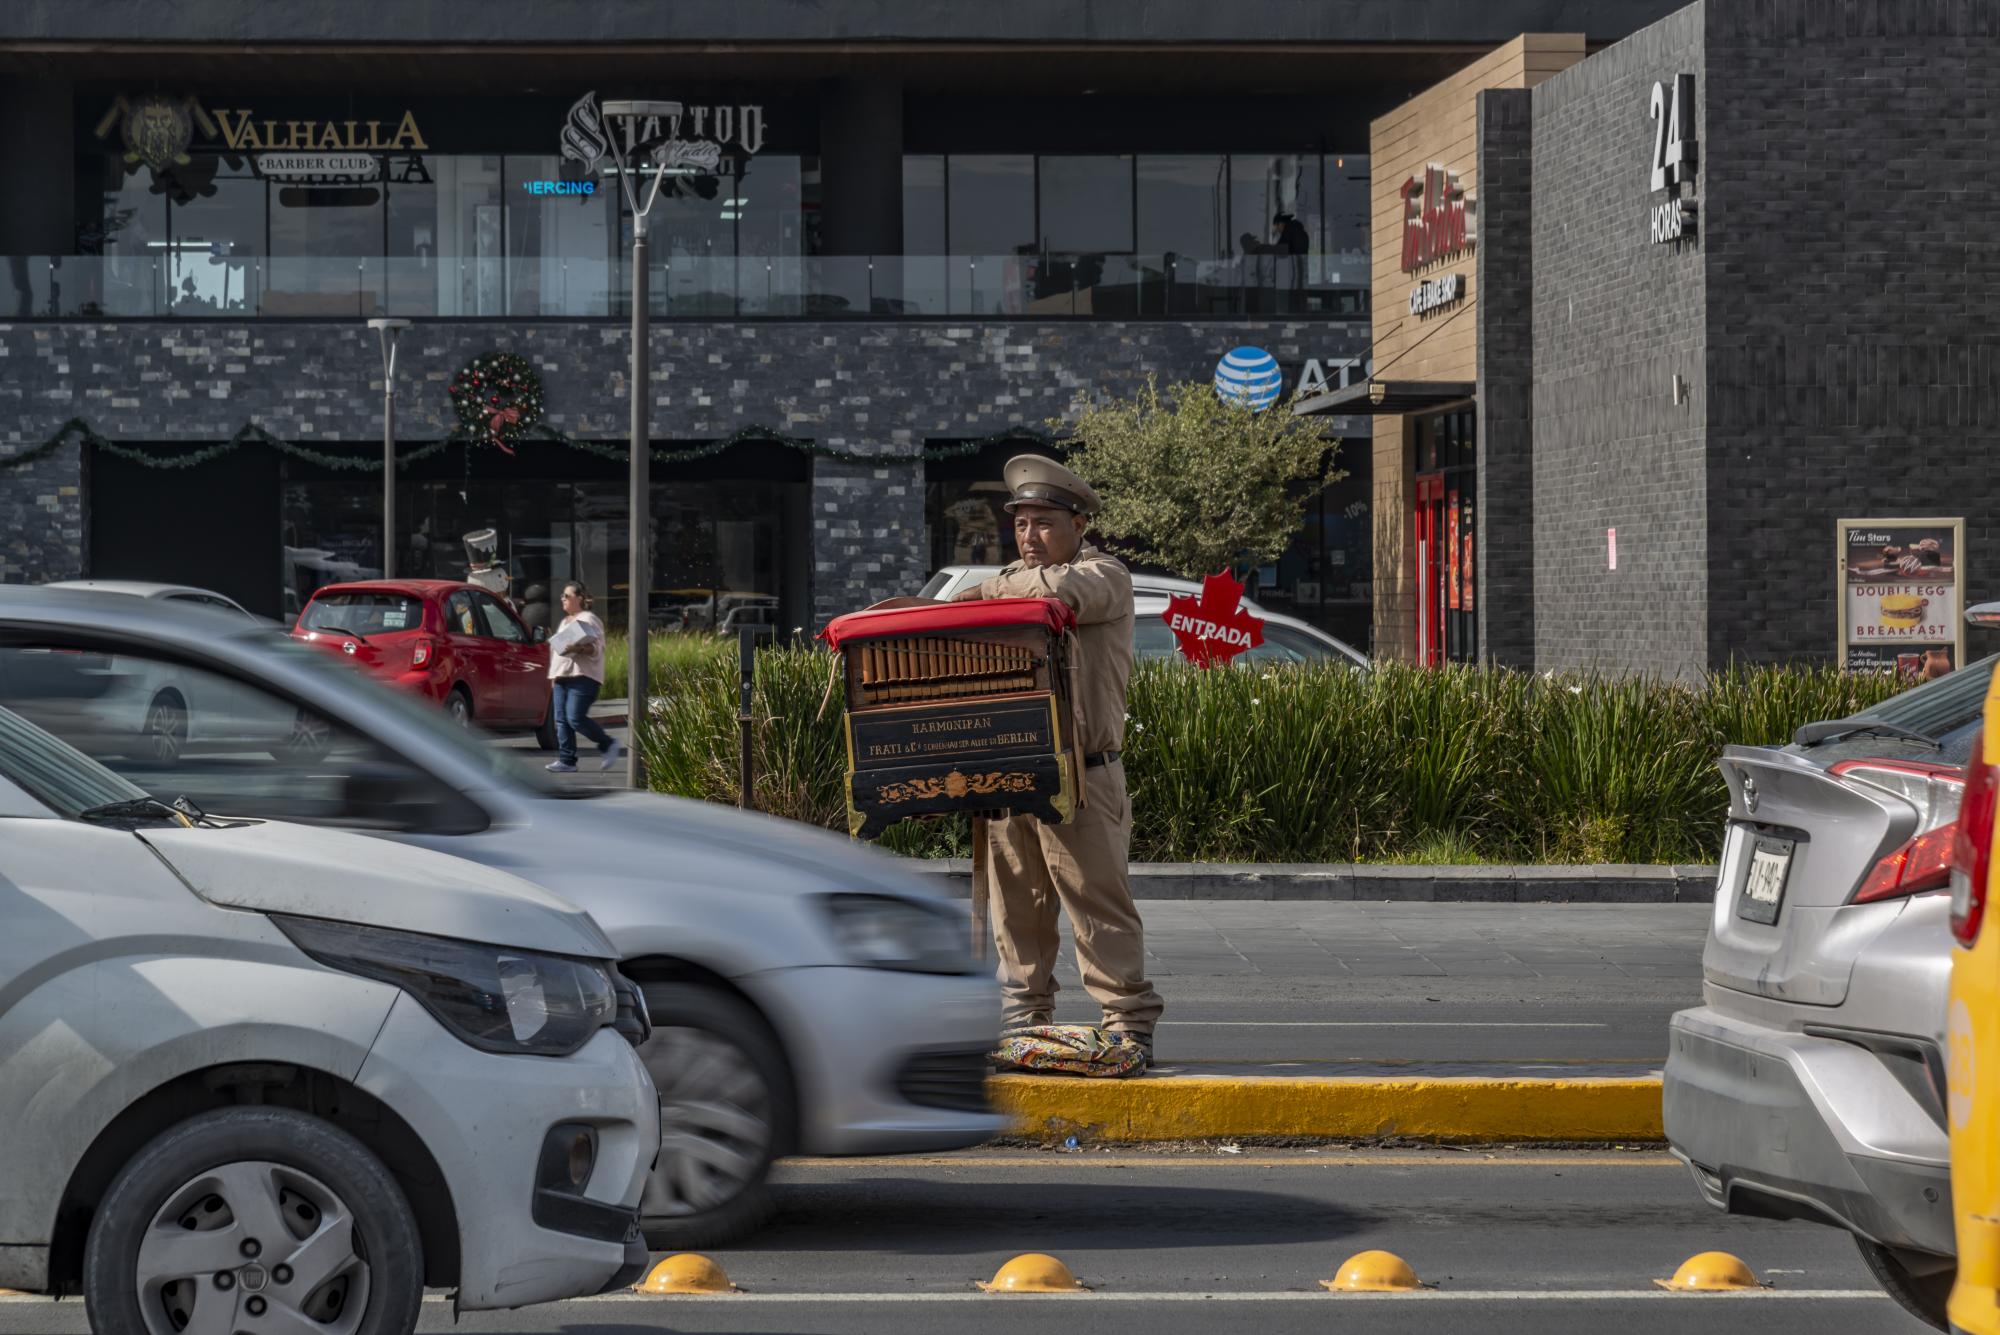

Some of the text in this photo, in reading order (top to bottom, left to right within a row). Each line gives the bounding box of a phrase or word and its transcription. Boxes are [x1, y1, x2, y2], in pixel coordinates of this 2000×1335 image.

[1650, 72, 1682, 192] 24
[266, 157, 368, 170] BARBER CLUB
[1651, 197, 1682, 245] HORAS
[1848, 529, 1891, 542] Tim Stars
[1917, 585, 1946, 596] EGG
[1170, 613, 1252, 649] ENTRADA
[1856, 625, 1946, 636] BREAKFAST
[911, 717, 992, 734] HARMONIPAN
[869, 743, 902, 756] FRATI
[996, 731, 1038, 745] BERLIN
